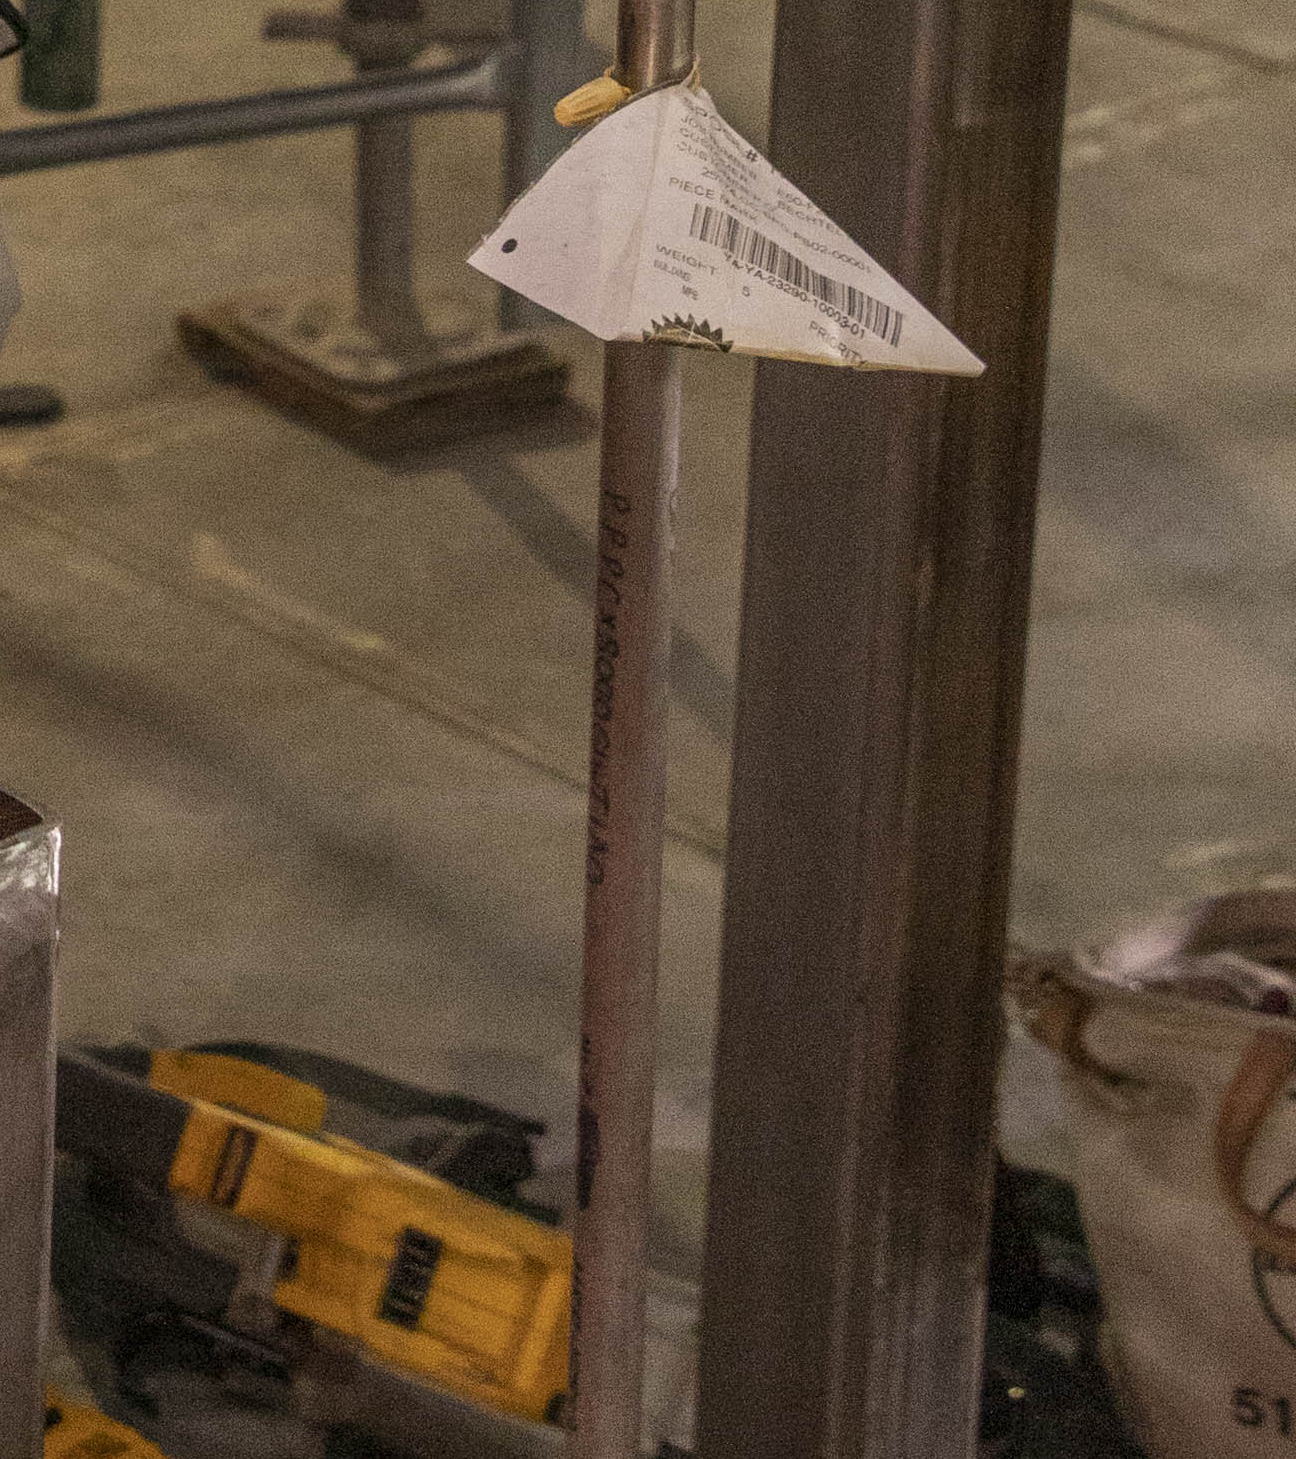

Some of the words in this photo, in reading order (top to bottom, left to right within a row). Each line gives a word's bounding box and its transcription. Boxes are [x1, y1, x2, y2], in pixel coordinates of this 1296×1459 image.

[745, 148, 759, 163] #
[669, 176, 715, 200] PIECE
[656, 244, 719, 277] WEIGHT
[741, 286, 751, 298] 5
